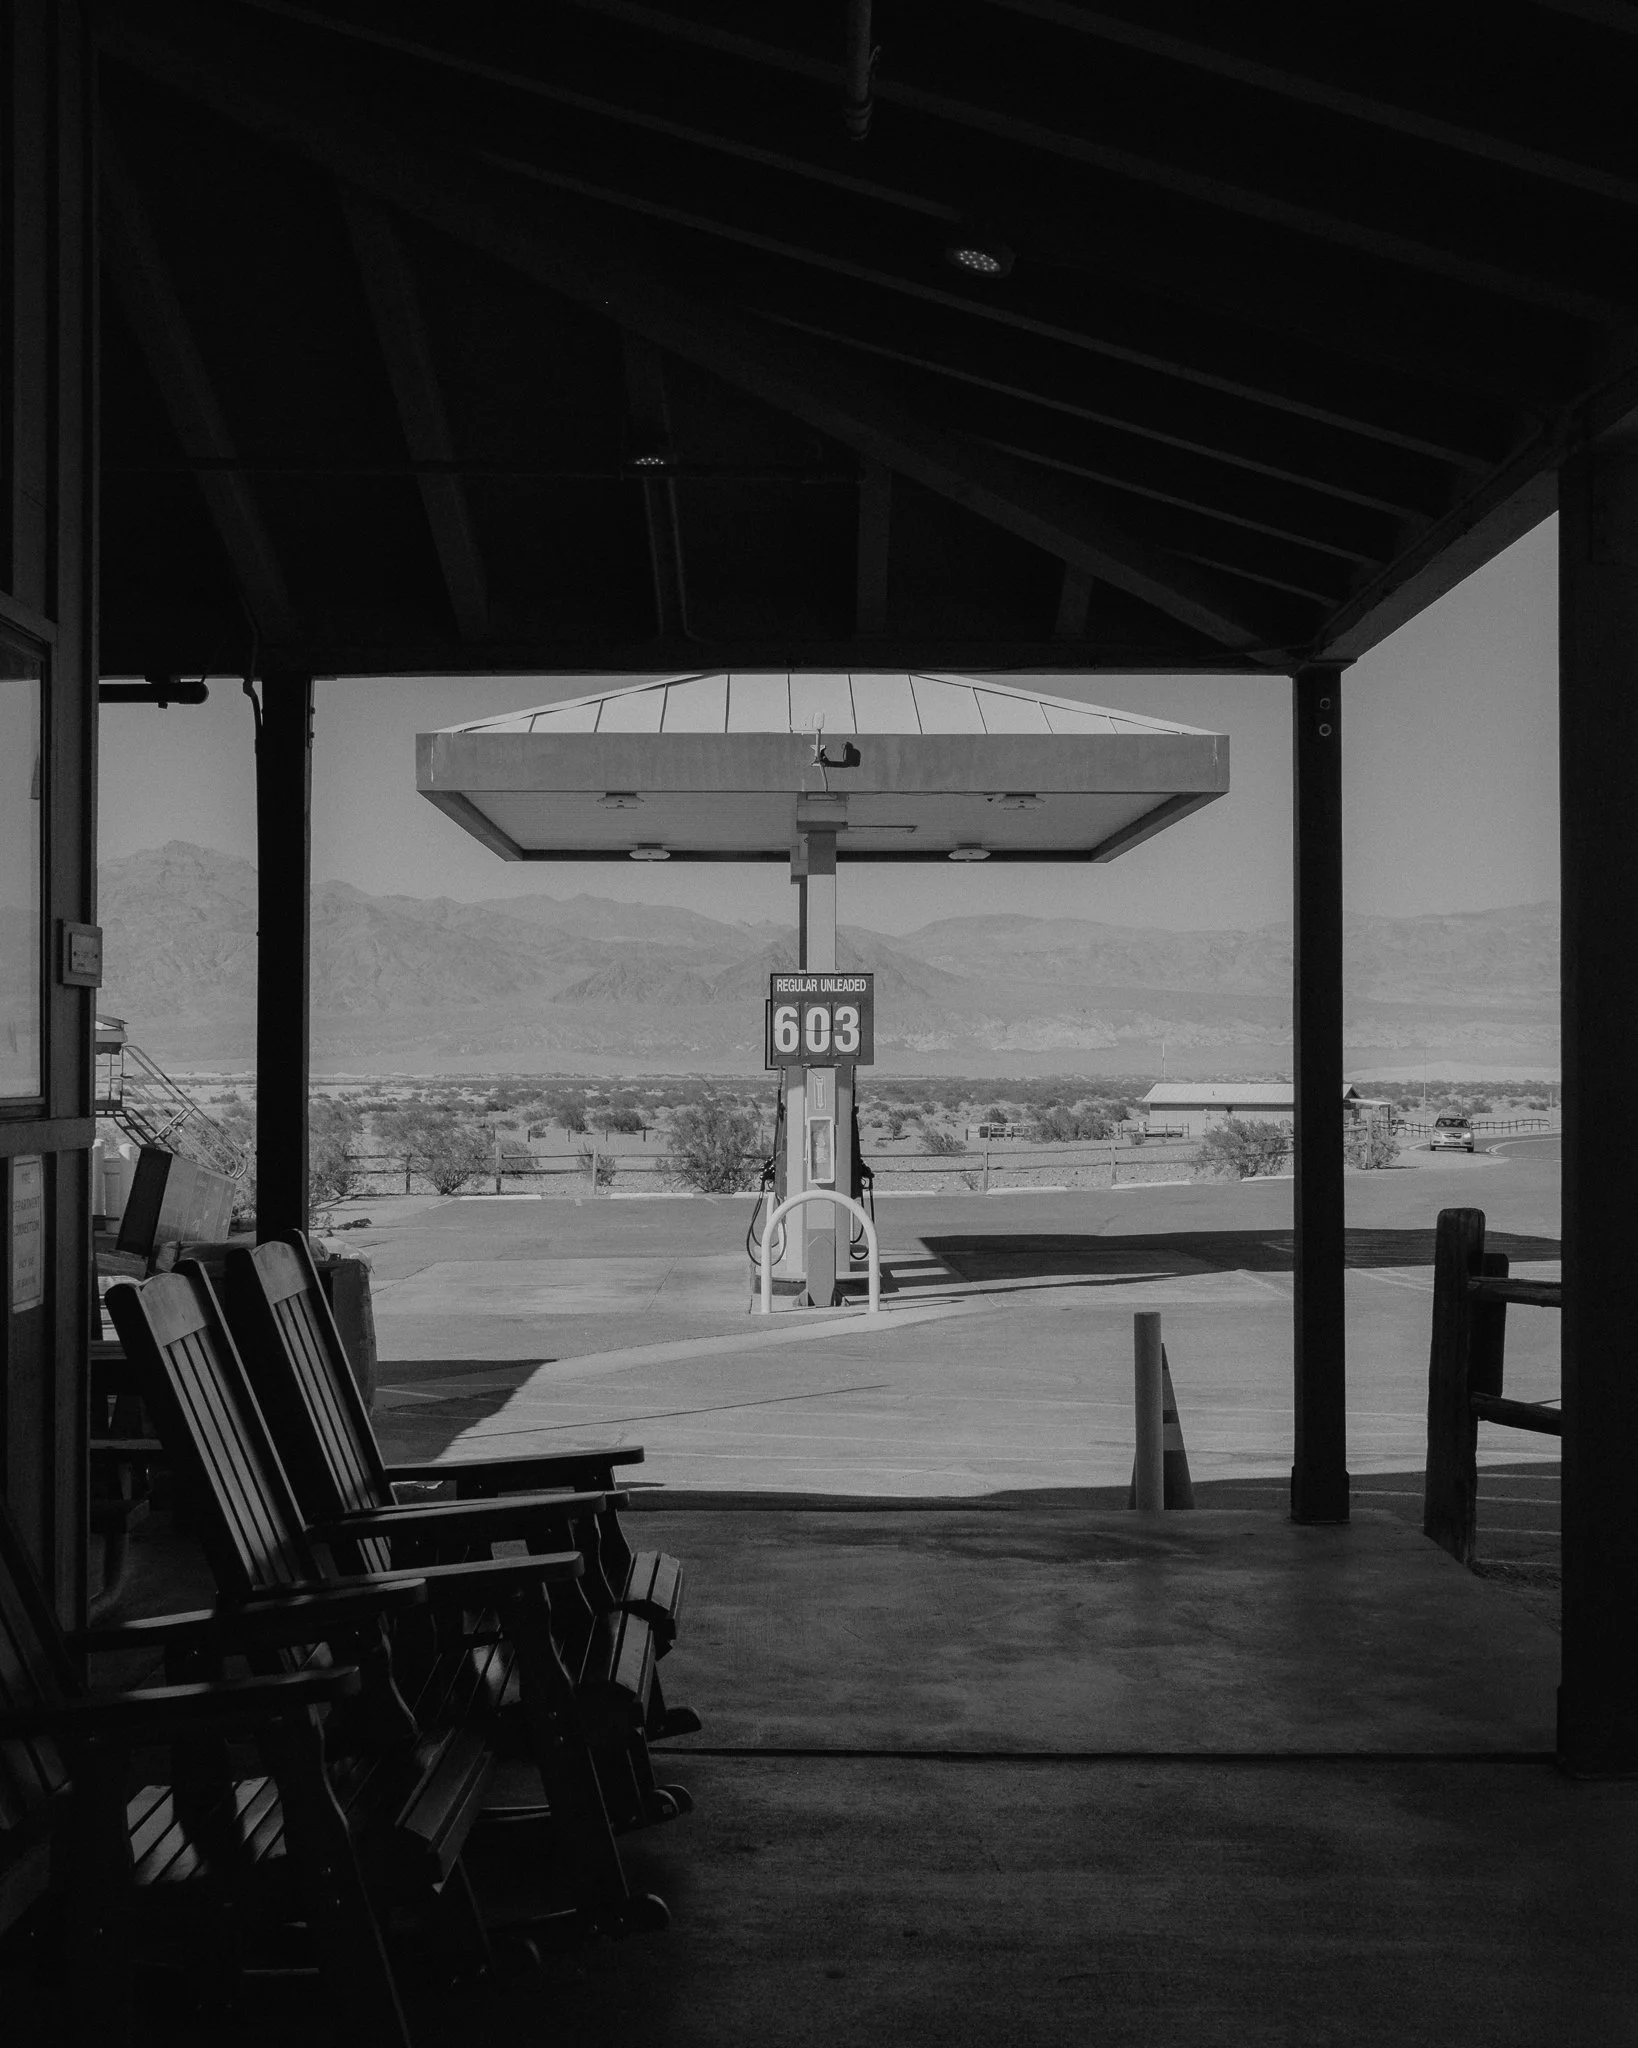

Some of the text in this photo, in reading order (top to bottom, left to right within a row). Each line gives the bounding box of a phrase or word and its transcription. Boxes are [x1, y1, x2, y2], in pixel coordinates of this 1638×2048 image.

[776, 979, 867, 992] REGULAR UNLEADED
[774, 1005, 860, 1053] 603
